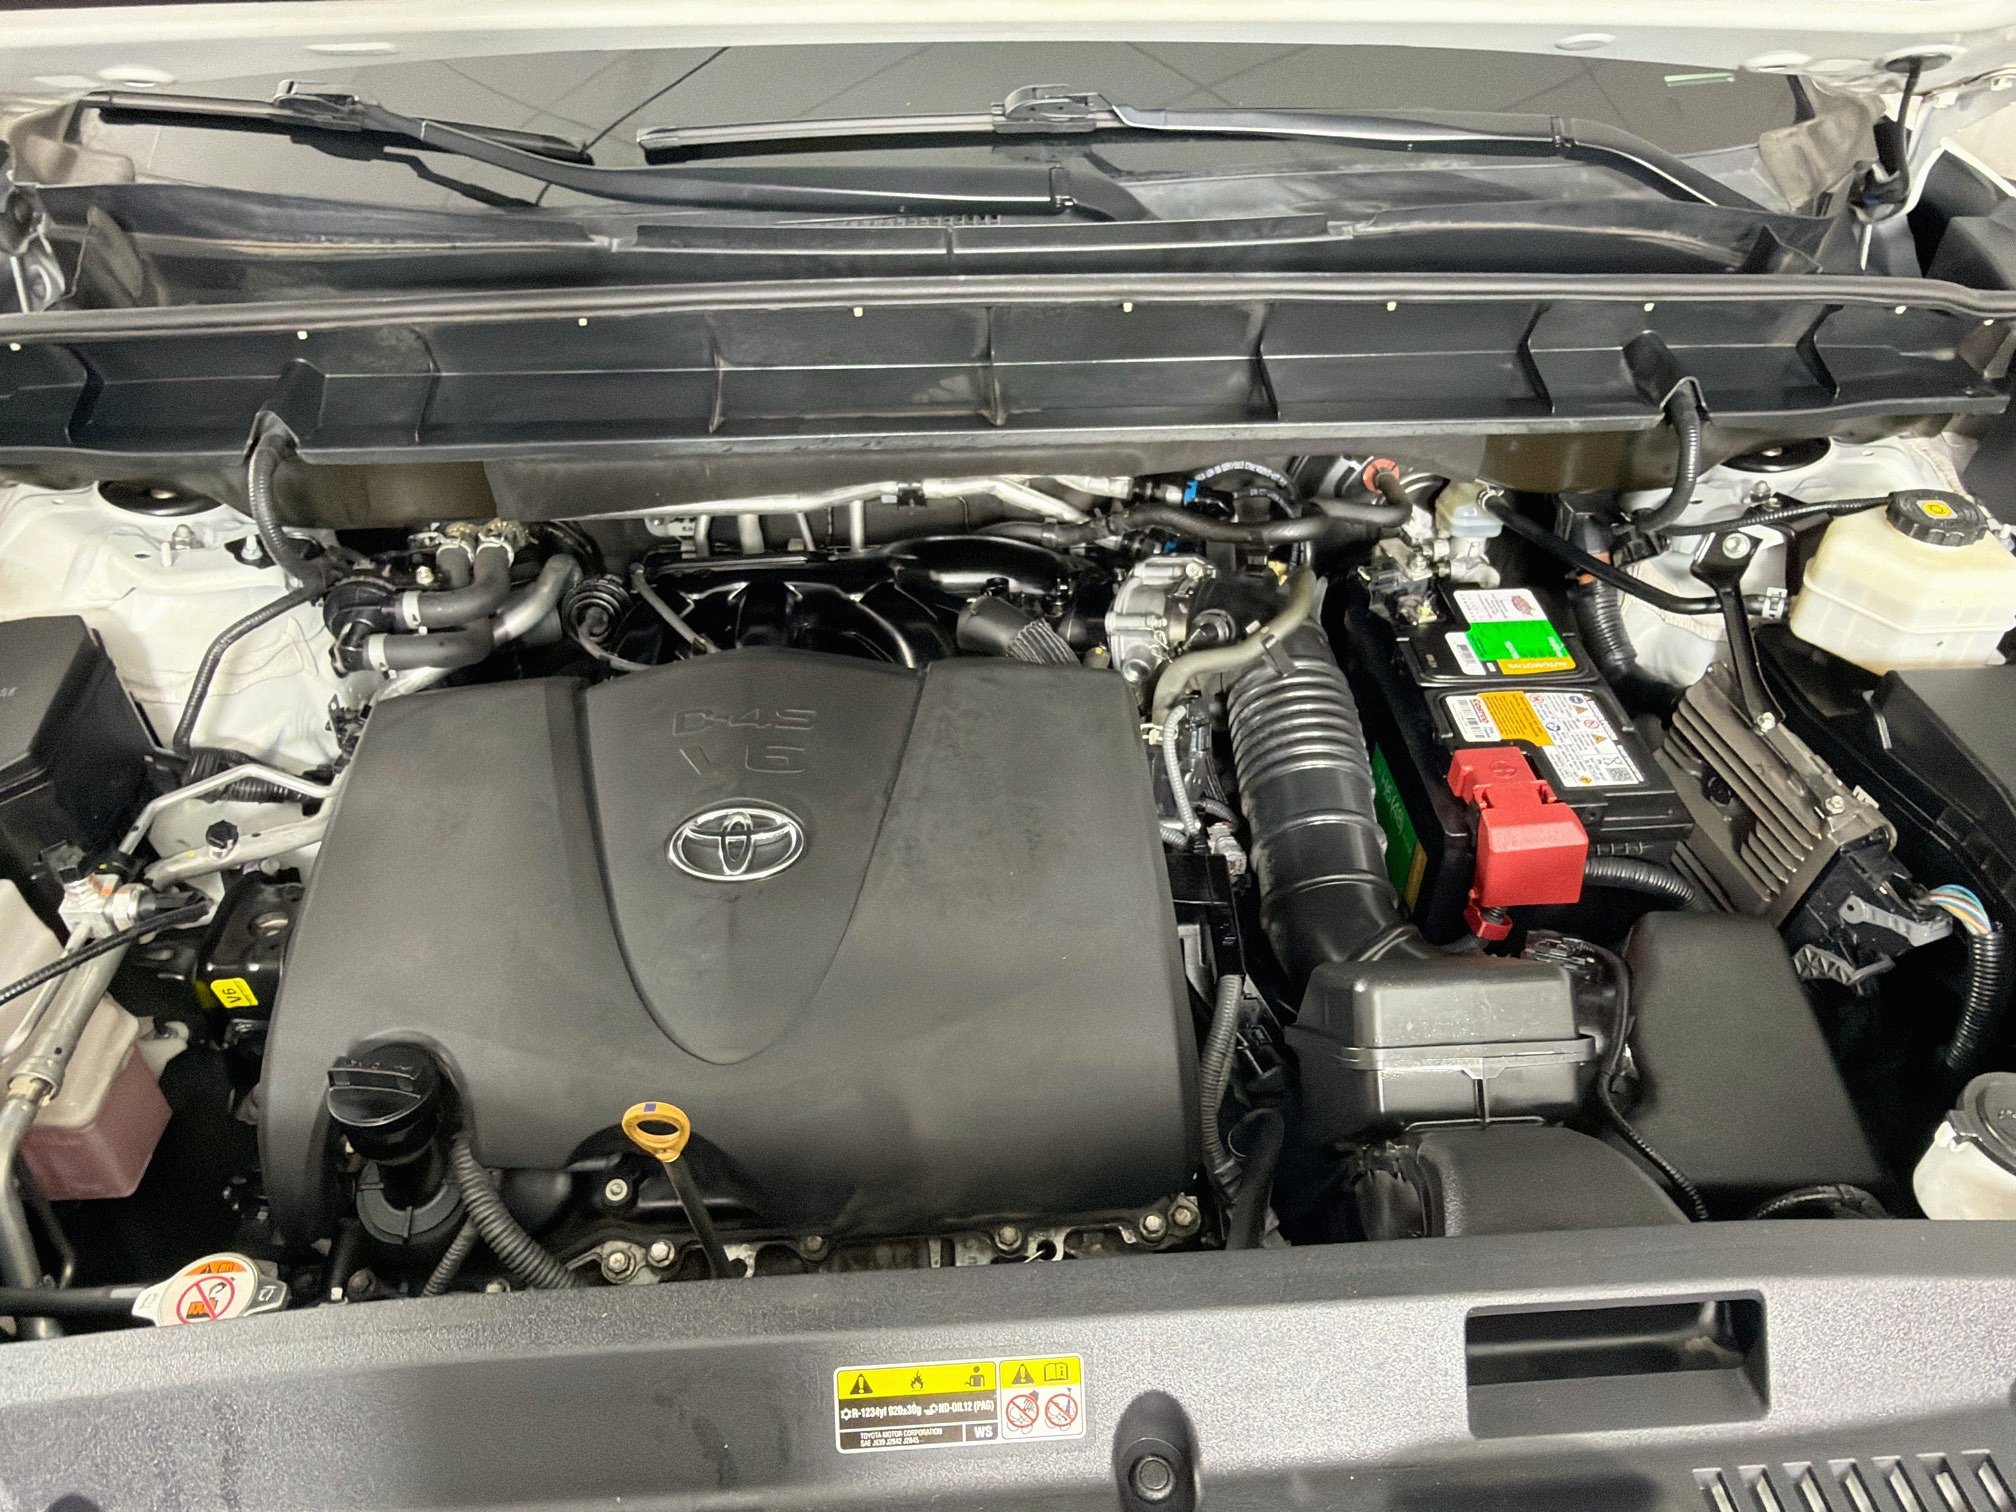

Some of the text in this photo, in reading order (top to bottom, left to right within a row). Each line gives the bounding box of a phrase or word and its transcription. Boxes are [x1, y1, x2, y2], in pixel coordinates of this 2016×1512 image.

[679, 745, 806, 775] V6
[222, 987, 242, 1004] V6
[973, 1399, 995, 1413] (PAG)
[860, 1427, 943, 1440] TOYOTA MOTOR CORPORATION
[973, 1425, 994, 1439] WS
